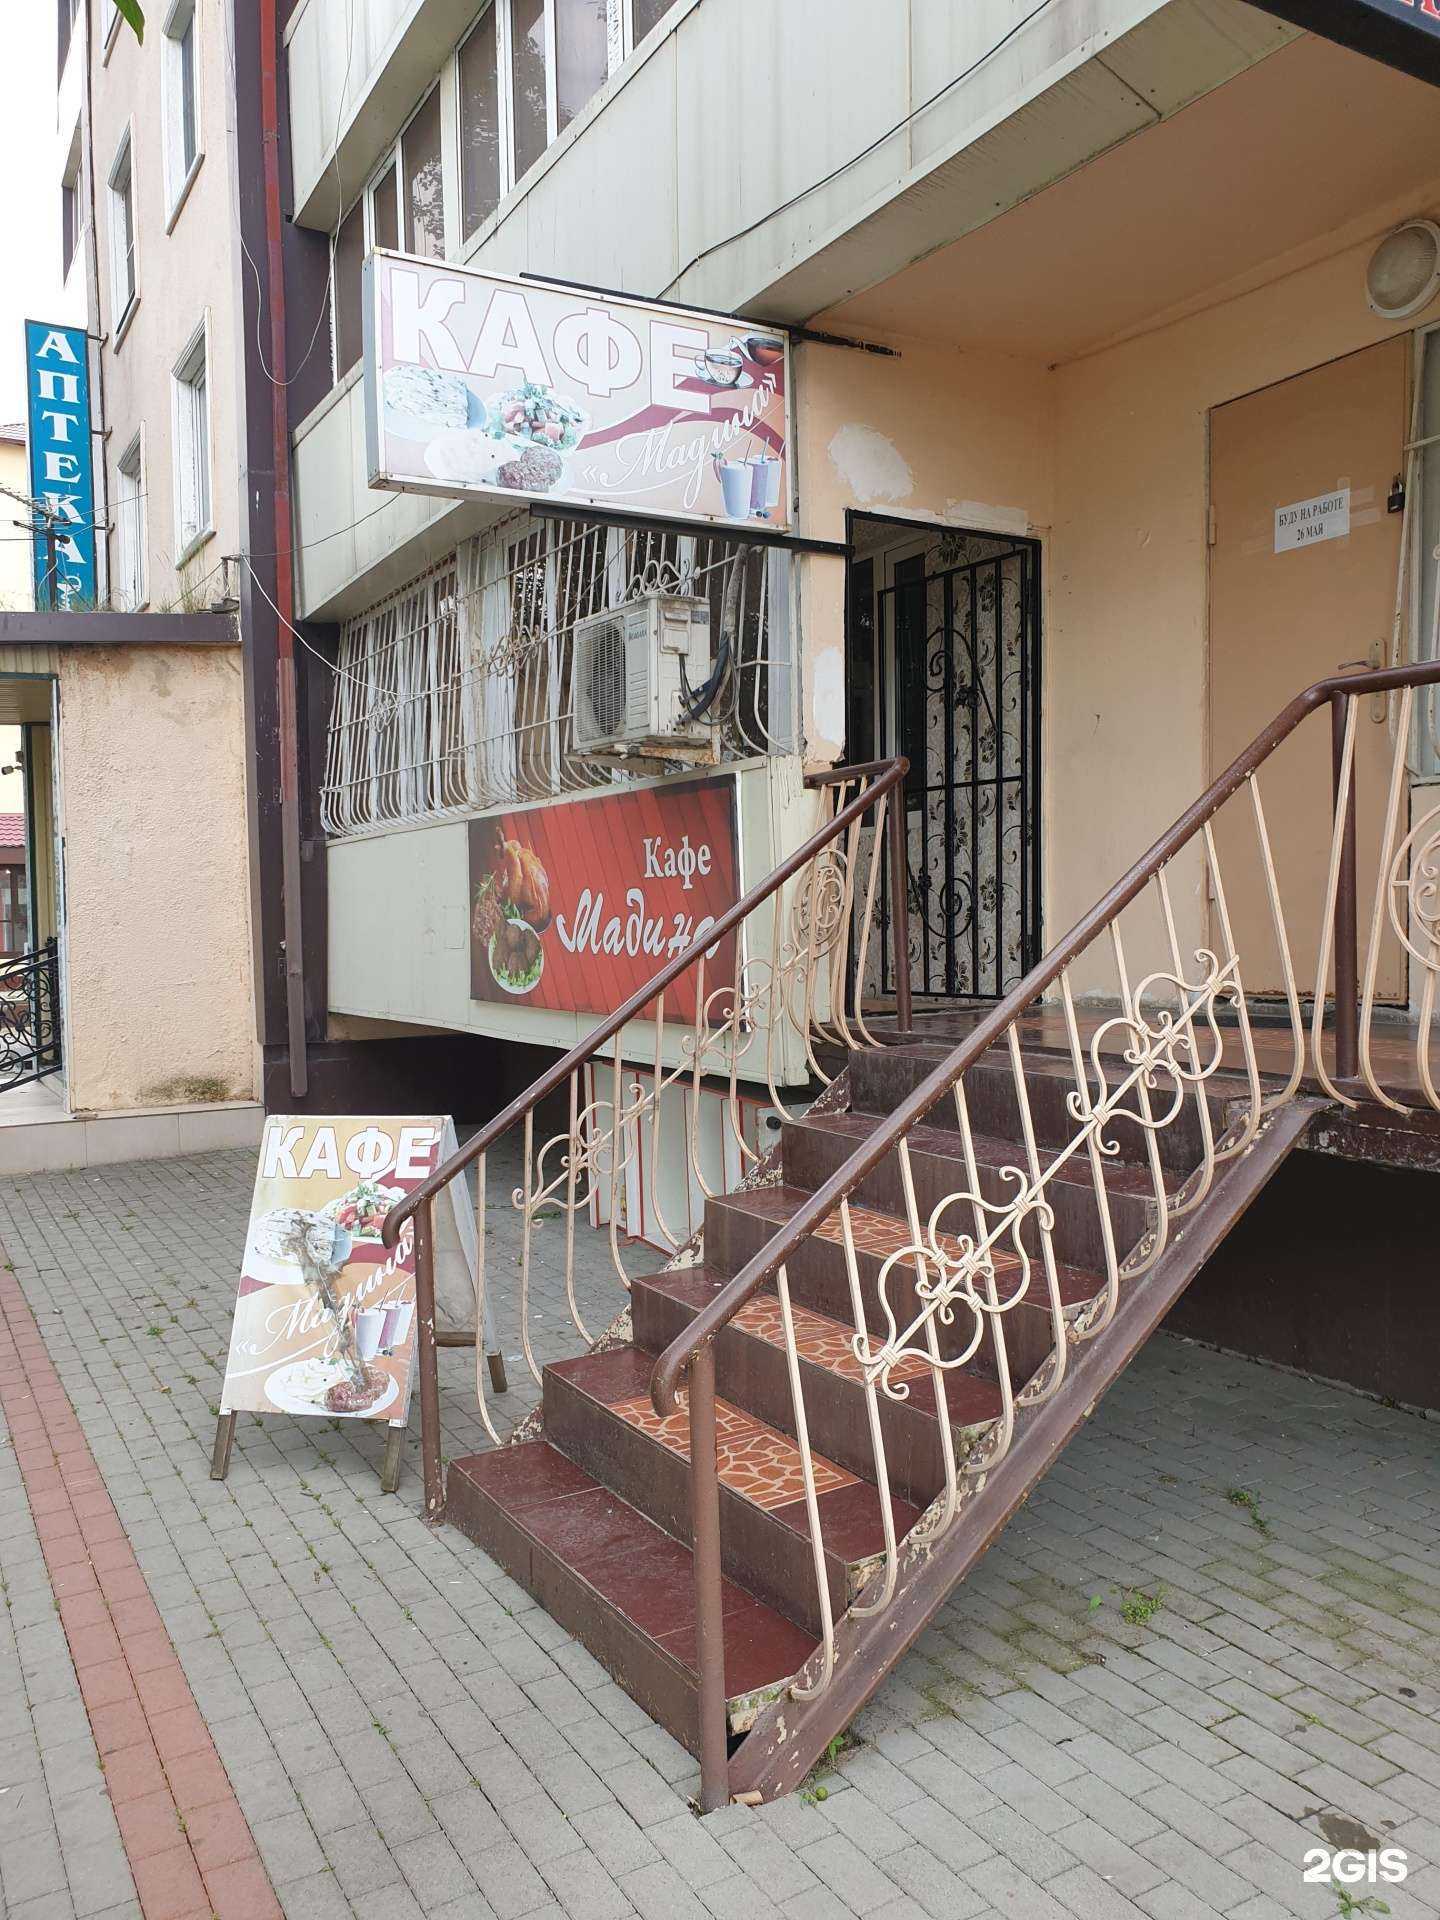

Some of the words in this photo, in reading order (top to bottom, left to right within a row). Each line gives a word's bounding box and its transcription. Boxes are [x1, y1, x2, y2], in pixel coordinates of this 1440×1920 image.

[388, 266, 712, 415] КАФЕ
[35, 330, 87, 565] АПТЕКА
[1280, 510, 1298, 527] БУДУ
[1301, 507, 1311, 521] НА
[1312, 497, 1344, 517] РАБОТЕ
[1297, 529, 1304, 541] 26
[1306, 522, 1324, 538] МАЯ
[642, 835, 712, 890] Кафе
[556, 888, 720, 960] Мадина
[262, 1125, 436, 1180] КАФЕ
